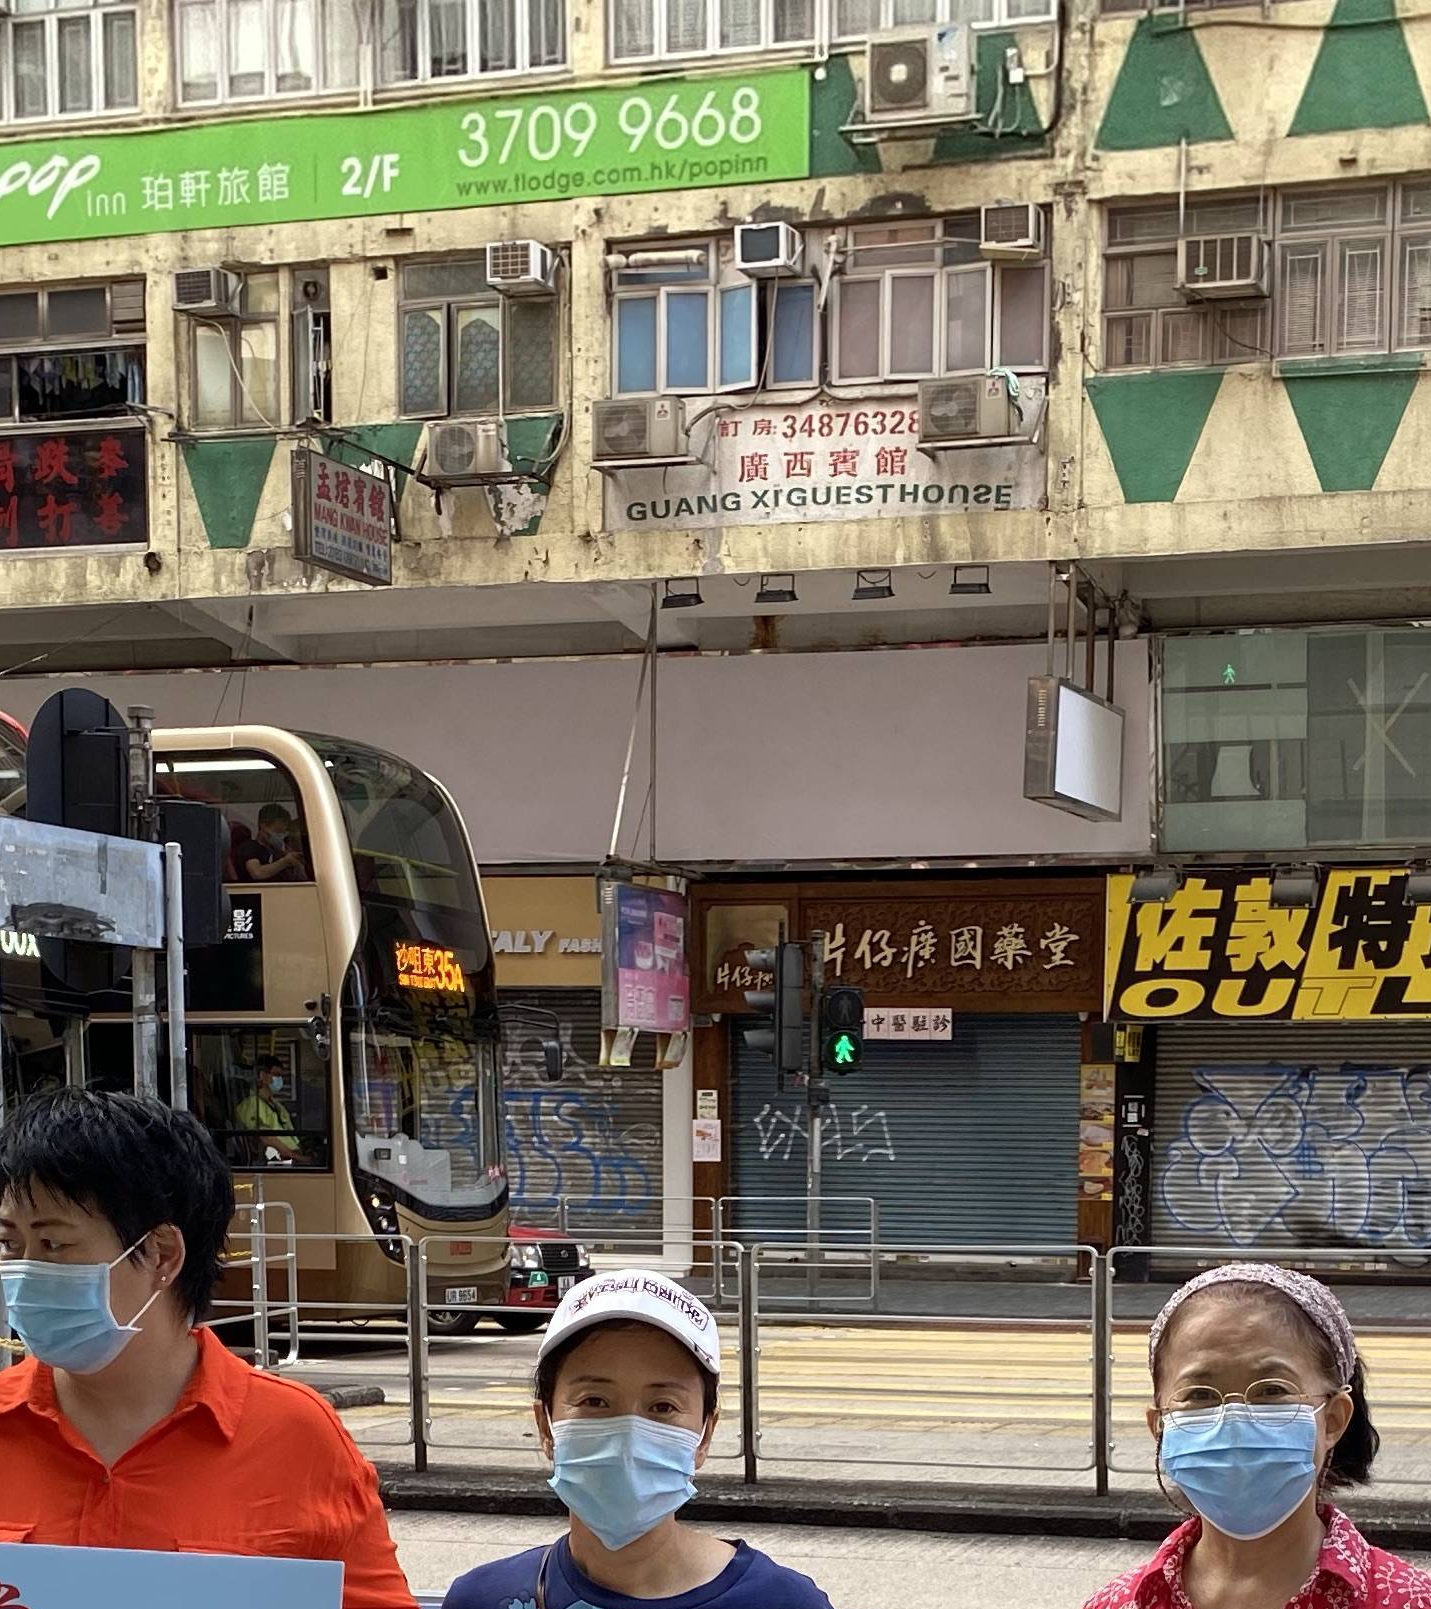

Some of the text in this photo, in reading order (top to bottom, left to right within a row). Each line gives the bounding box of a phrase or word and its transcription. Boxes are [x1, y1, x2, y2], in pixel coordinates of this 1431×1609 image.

[458, 87, 762, 167] 3709 9668
[141, 162, 290, 210] 珀軒旅館
[341, 153, 400, 199] 2/F
[782, 409, 920, 438] 34876328
[739, 447, 908, 482] 廣西賓館
[626, 492, 741, 521] GUANG
[435, 949, 465, 993] 35A
